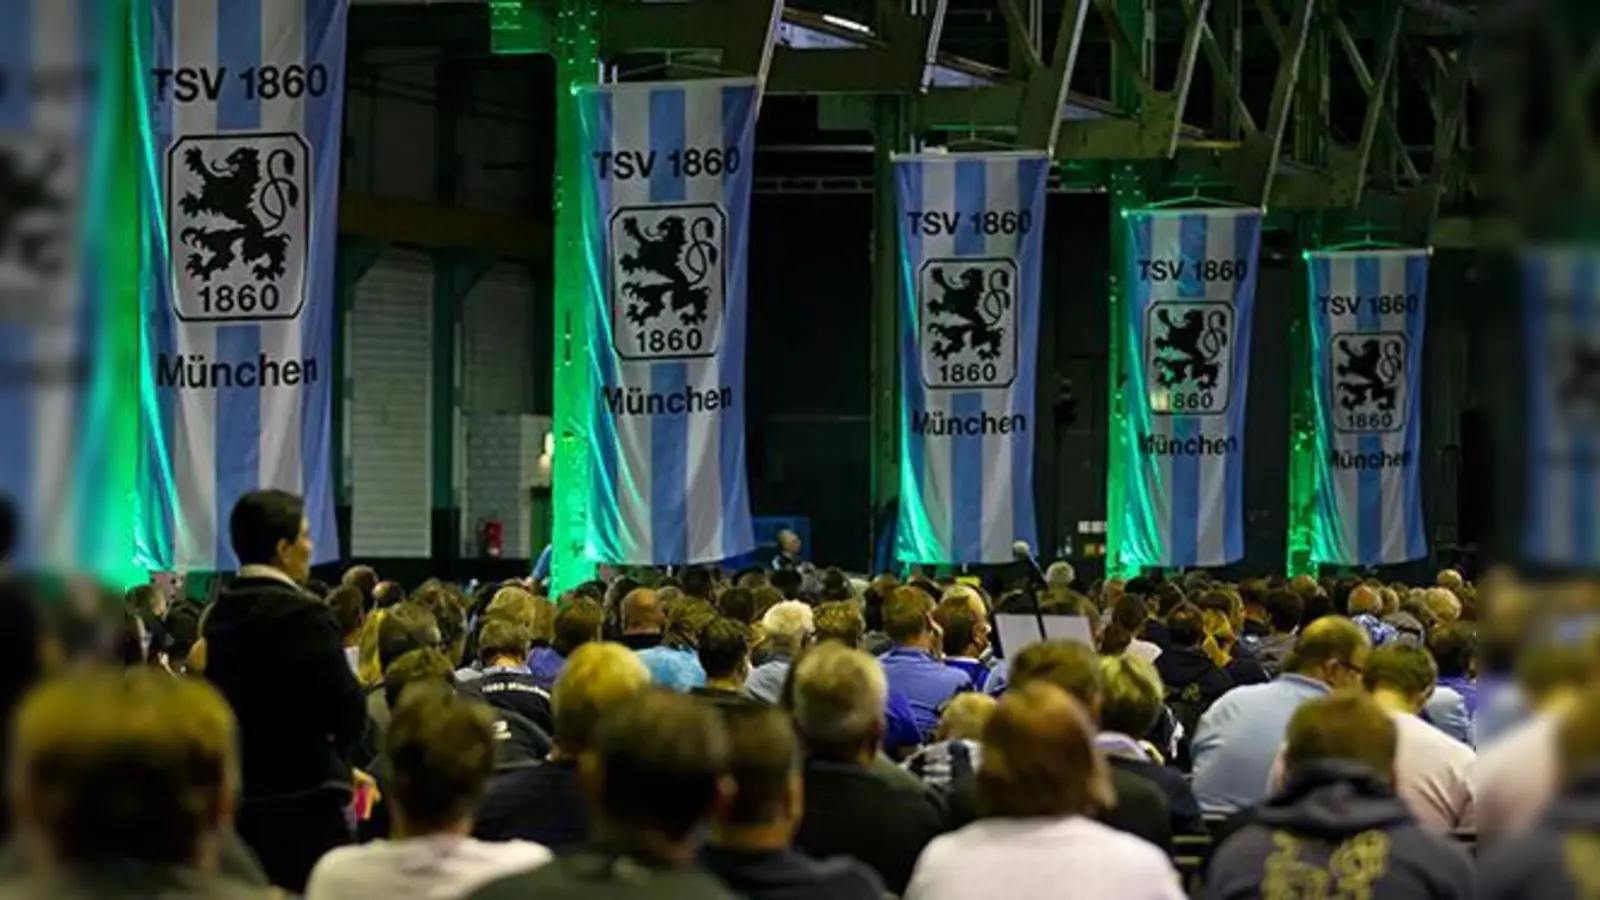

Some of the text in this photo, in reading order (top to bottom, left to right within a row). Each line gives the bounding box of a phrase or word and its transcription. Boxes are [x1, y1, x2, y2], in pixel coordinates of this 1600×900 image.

[151, 64, 328, 102] TSV 1860
[592, 147, 741, 180] TSV 1860
[907, 210, 1032, 235] TSV 1860
[1137, 260, 1248, 281] TSV 1860
[198, 284, 280, 312] 1860
[1318, 293, 1418, 315] TSV 1860
[635, 328, 703, 353] 1860
[156, 352, 318, 389] München
[939, 362, 998, 383] 1860
[602, 386, 732, 416] München
[911, 409, 1026, 436] München
[1347, 411, 1394, 428] 1860
[1138, 430, 1238, 456] München
[1329, 450, 1412, 471] München
